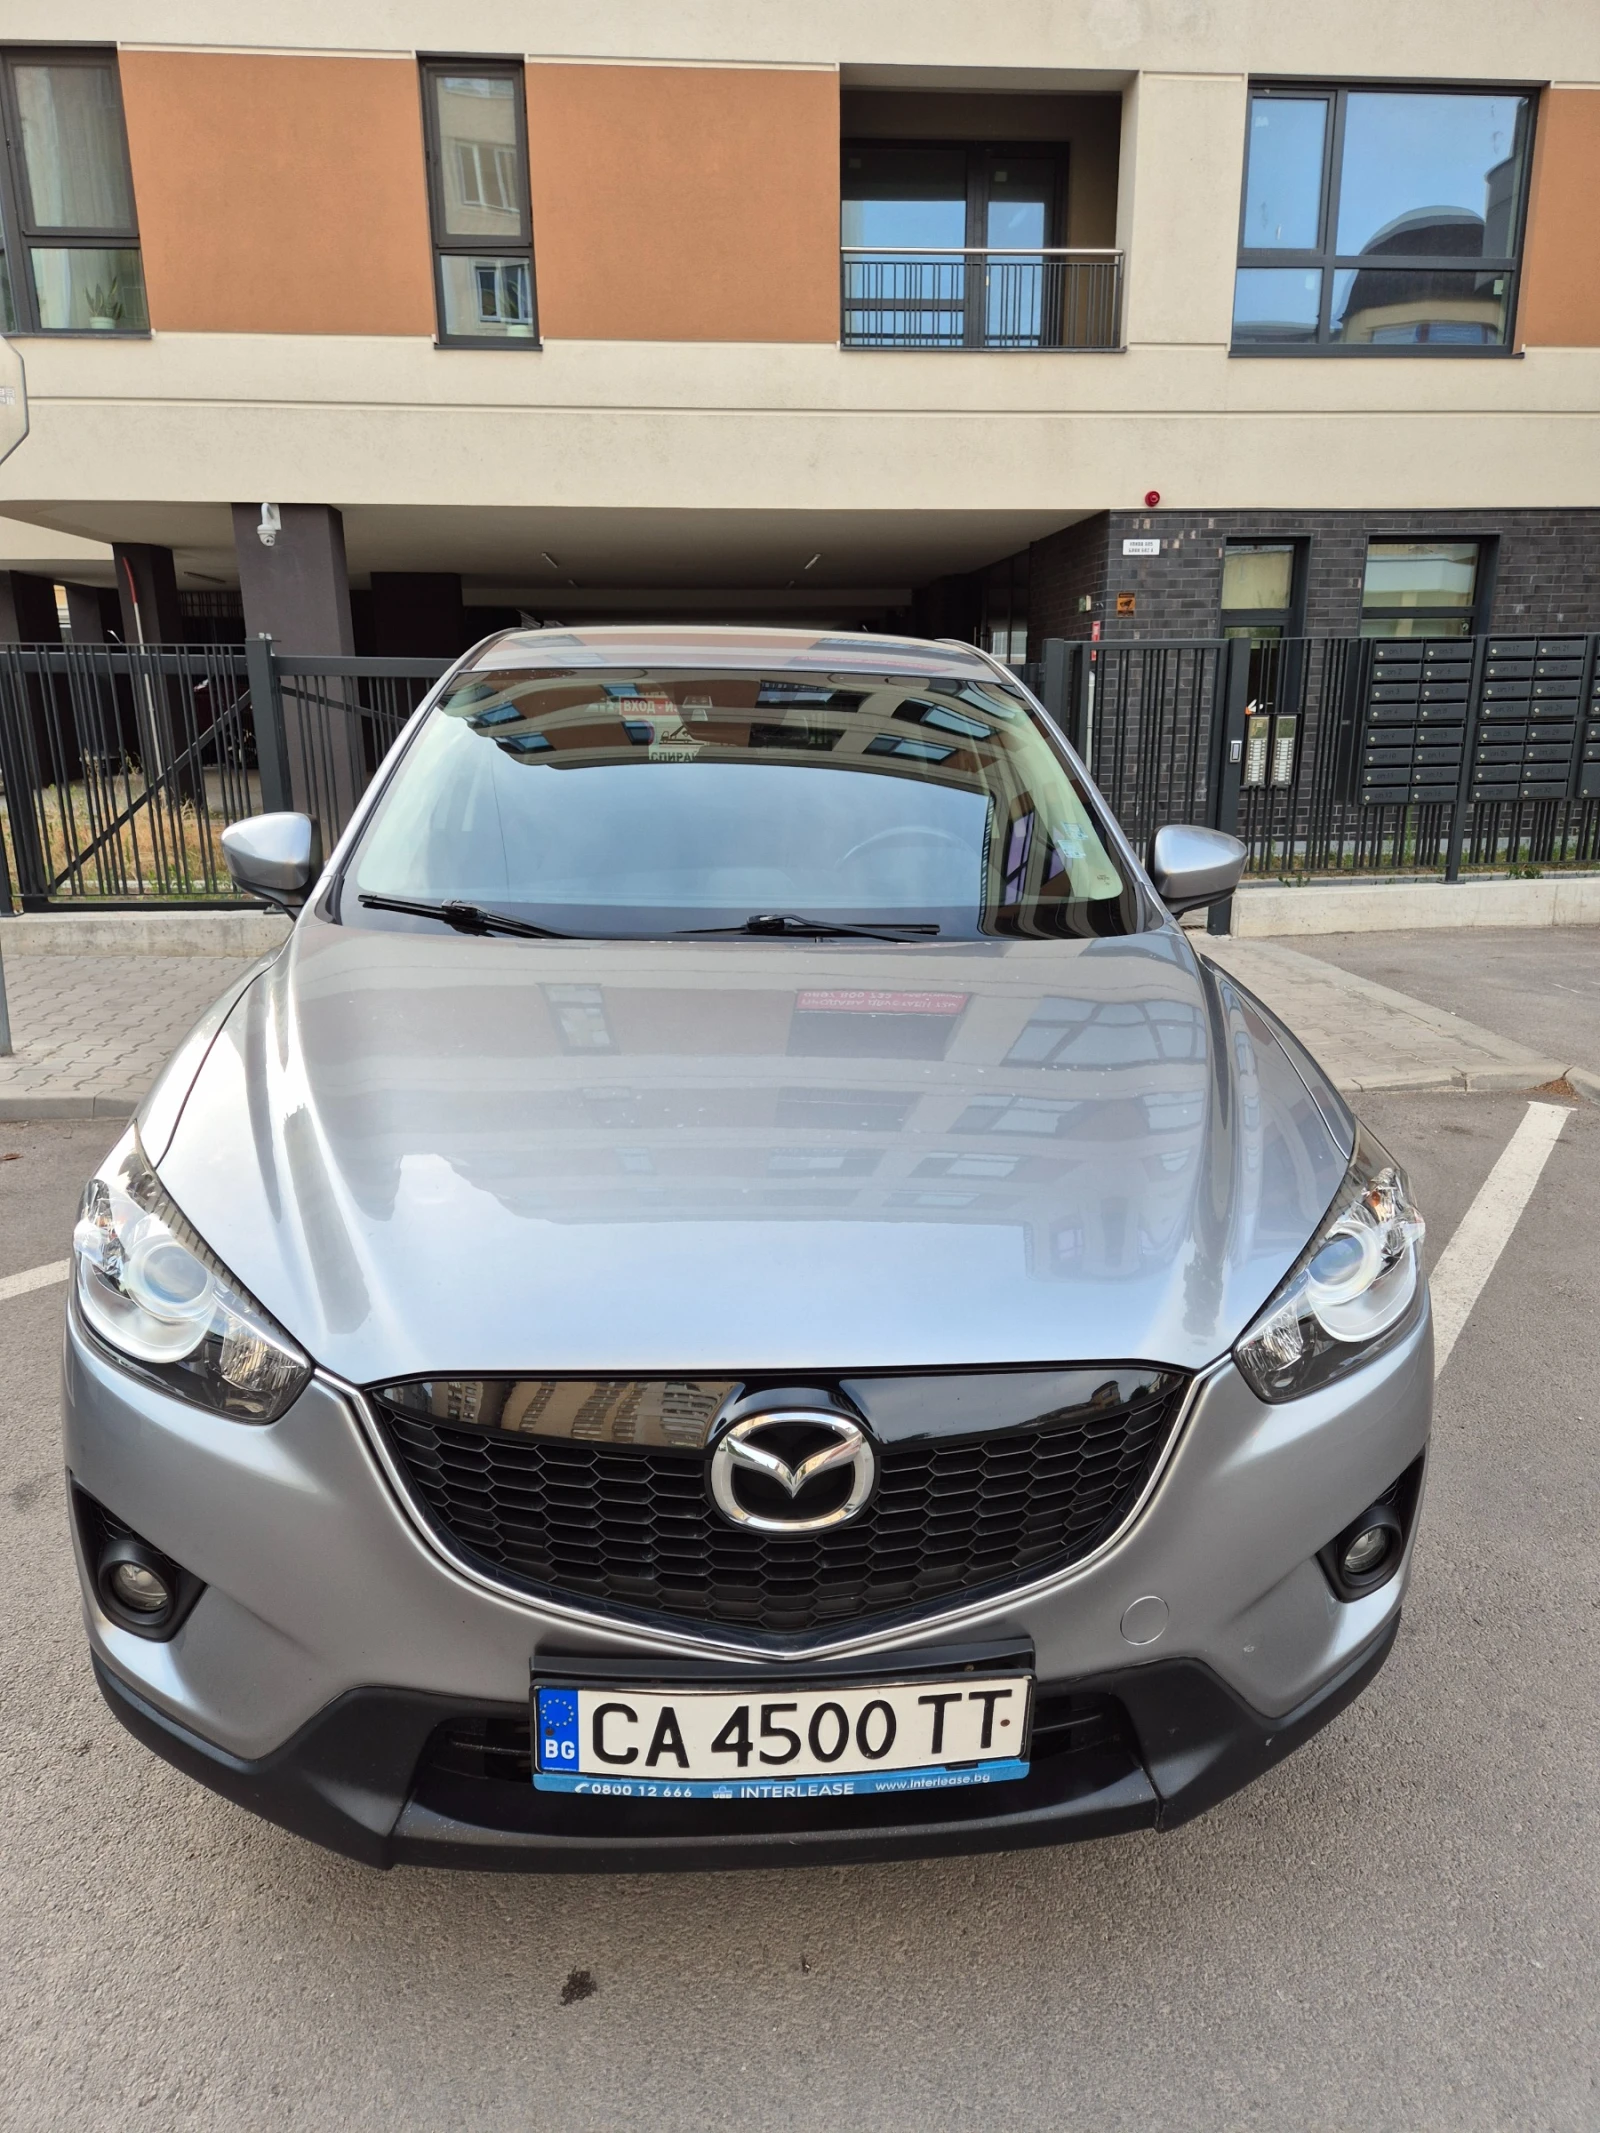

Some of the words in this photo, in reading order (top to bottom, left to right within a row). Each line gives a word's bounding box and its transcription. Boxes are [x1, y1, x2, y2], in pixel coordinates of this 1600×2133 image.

[623, 700, 655, 714] ВХОД
[592, 1702, 690, 1768] CA
[711, 1699, 897, 1768] 4500
[918, 1689, 1013, 1754] TT
[545, 1738, 576, 1760] BG
[591, 1784, 632, 1796] 0800
[638, 1786, 657, 1797] 12
[663, 1787, 693, 1798] 666
[740, 1783, 855, 1799] INTERLEASE
